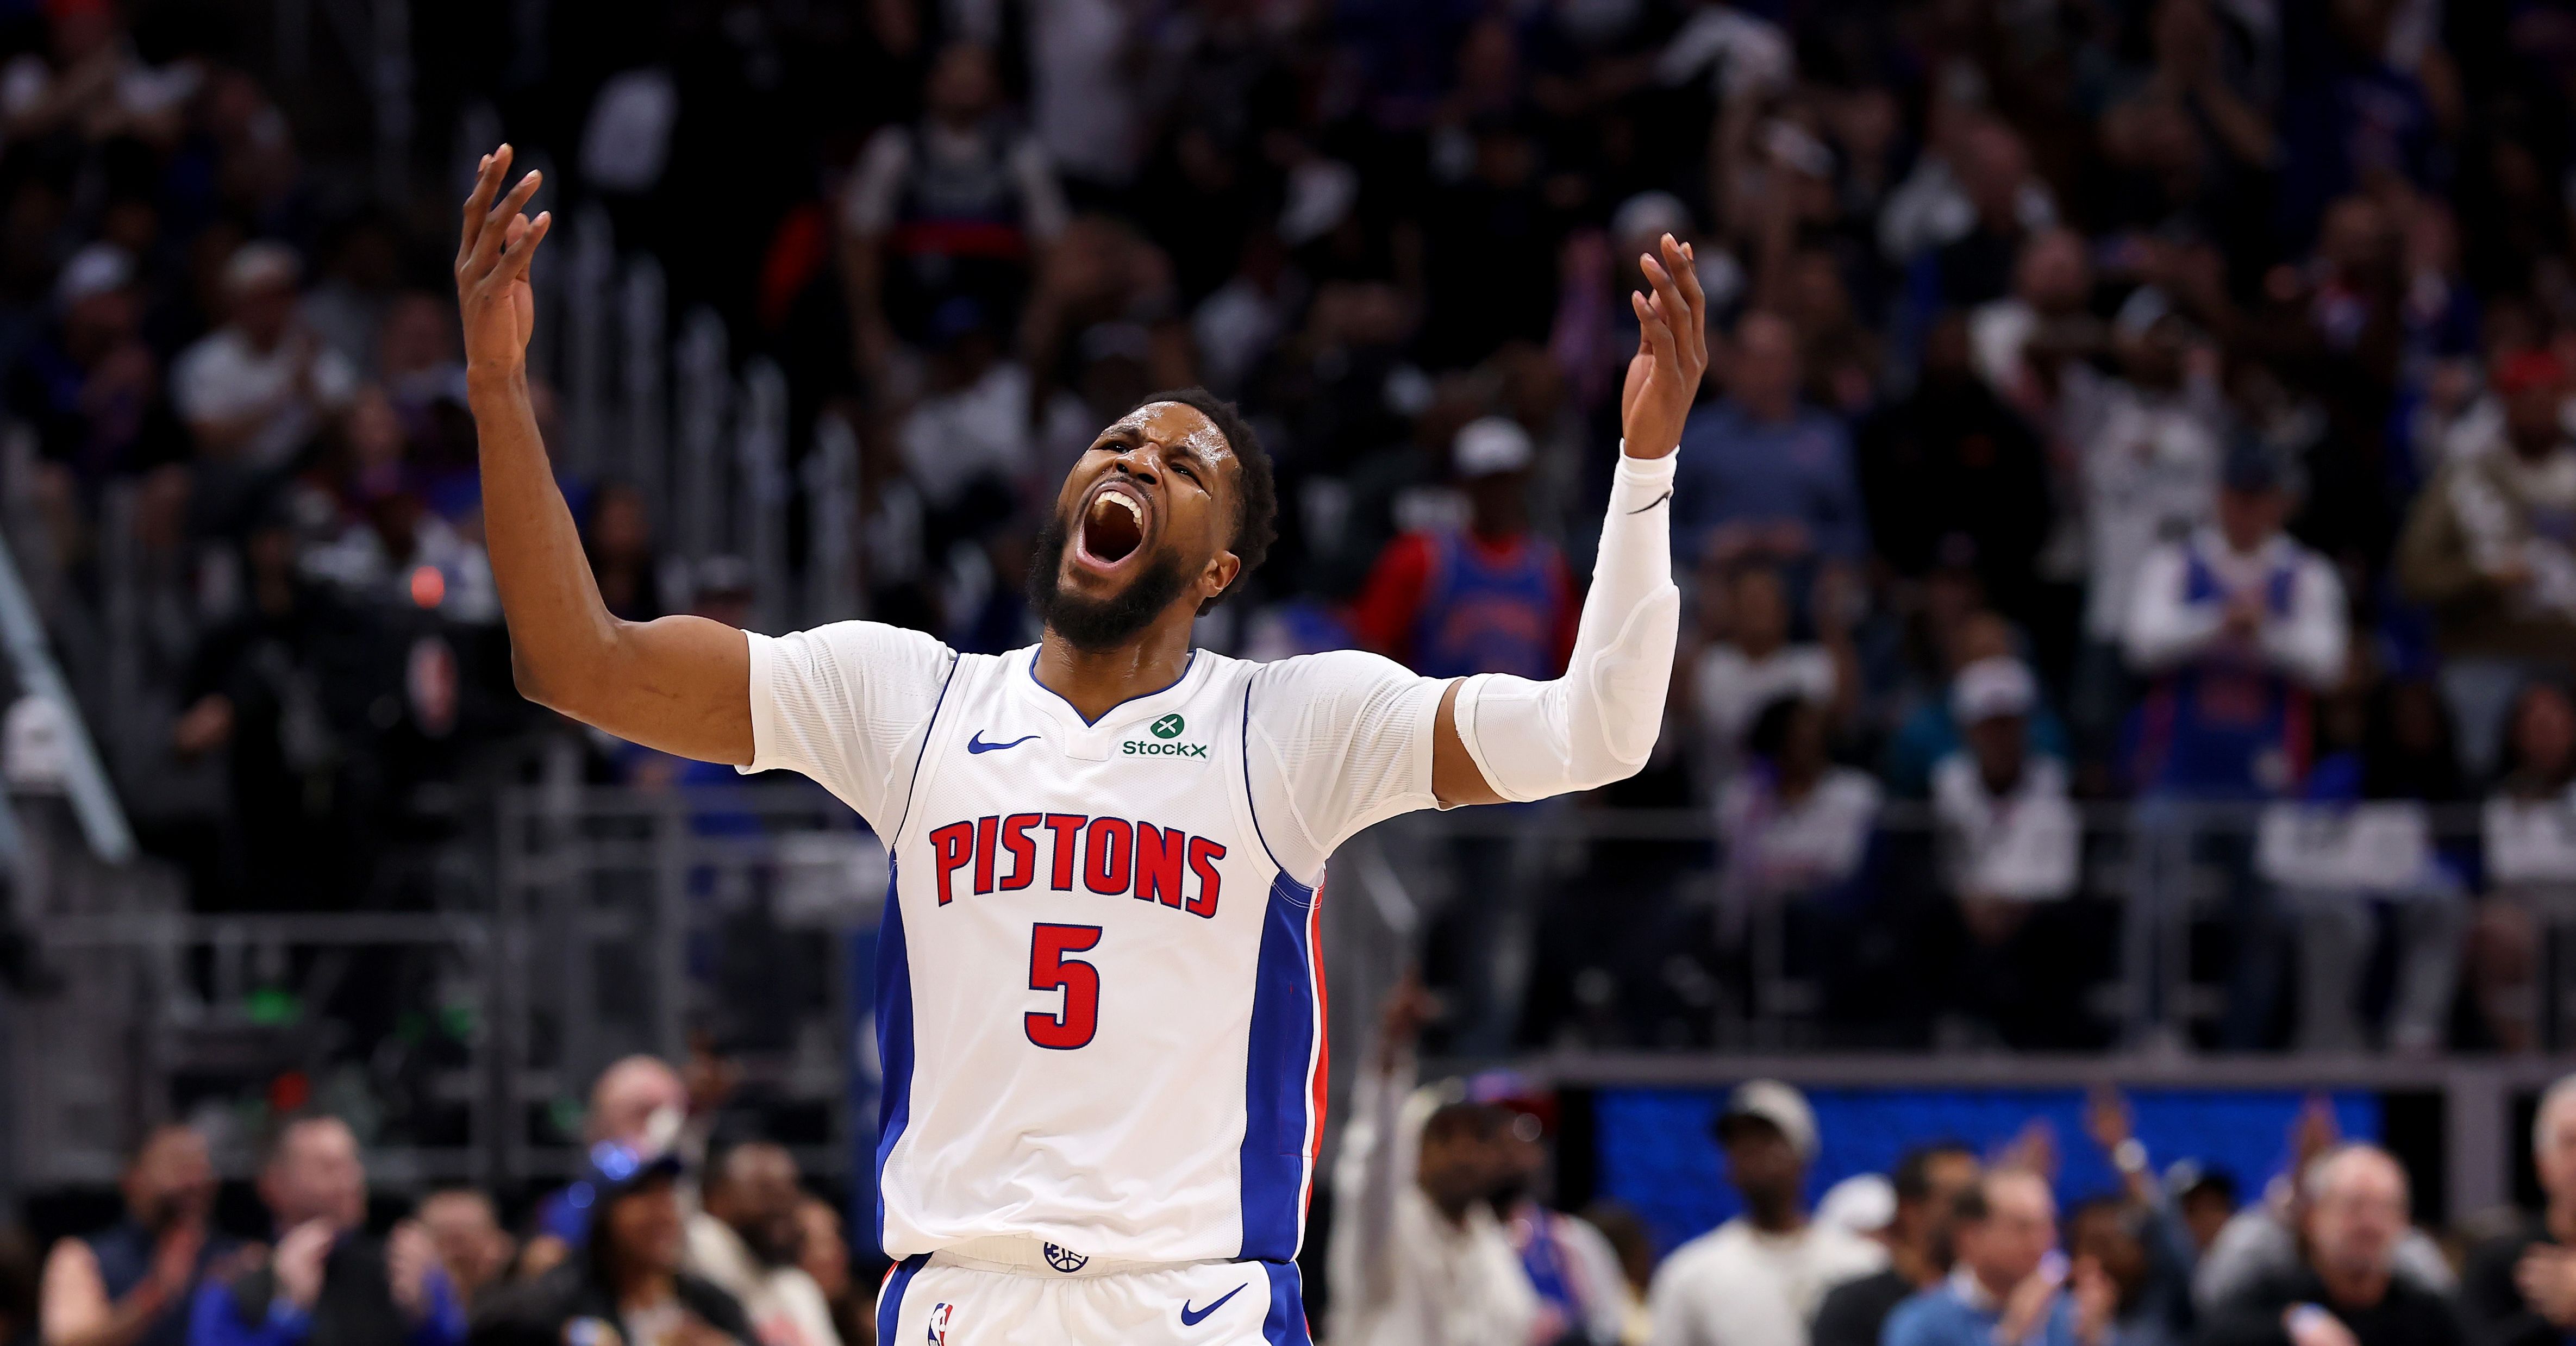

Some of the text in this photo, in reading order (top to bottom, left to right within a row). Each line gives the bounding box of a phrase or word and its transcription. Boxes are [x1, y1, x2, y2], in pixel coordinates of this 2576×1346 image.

[1122, 741, 1206, 759] StockX
[929, 813, 1226, 919] PISTONS
[1024, 923, 1102, 1050] 5
